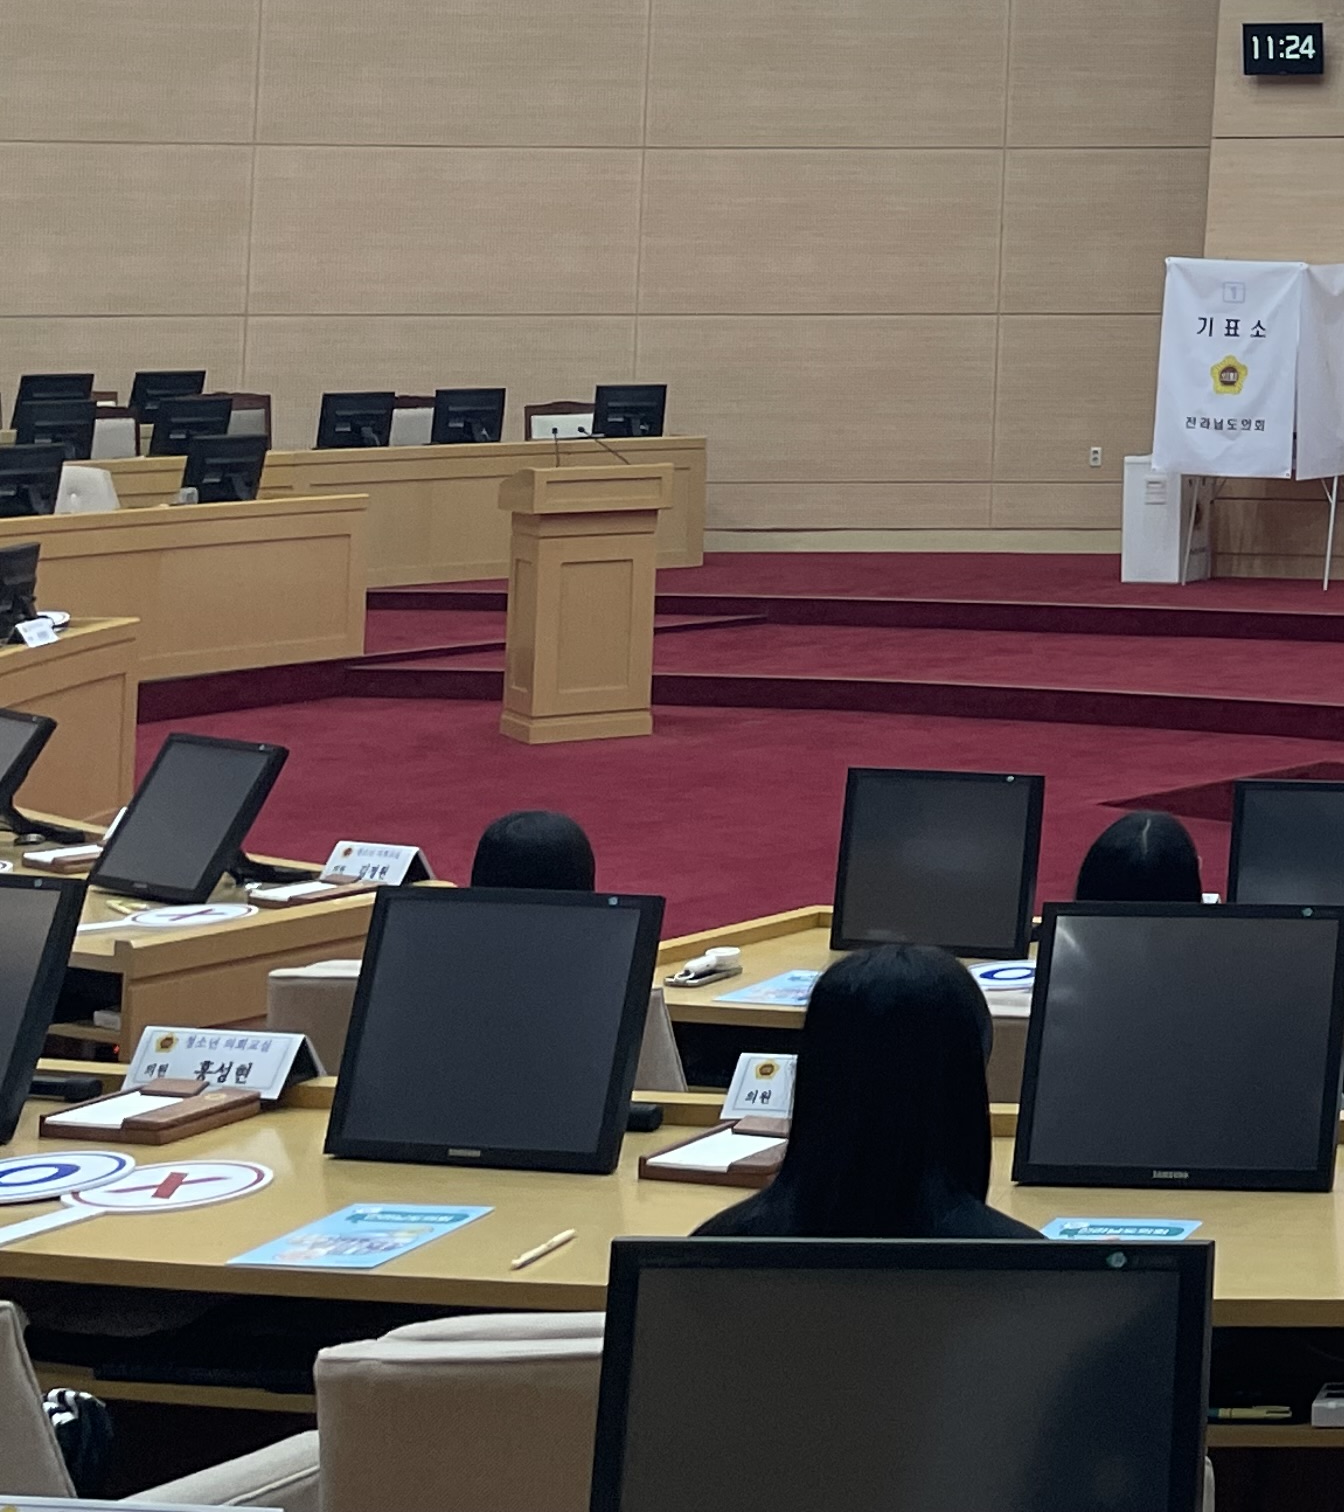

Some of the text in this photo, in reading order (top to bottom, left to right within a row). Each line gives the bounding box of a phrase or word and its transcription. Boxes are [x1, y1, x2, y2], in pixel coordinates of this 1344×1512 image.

[1252, 34, 1316, 60] 11:24
[1196, 316, 1267, 338] 기표소
[144, 1063, 169, 1078] 의원
[745, 1090, 772, 1104] 의원
